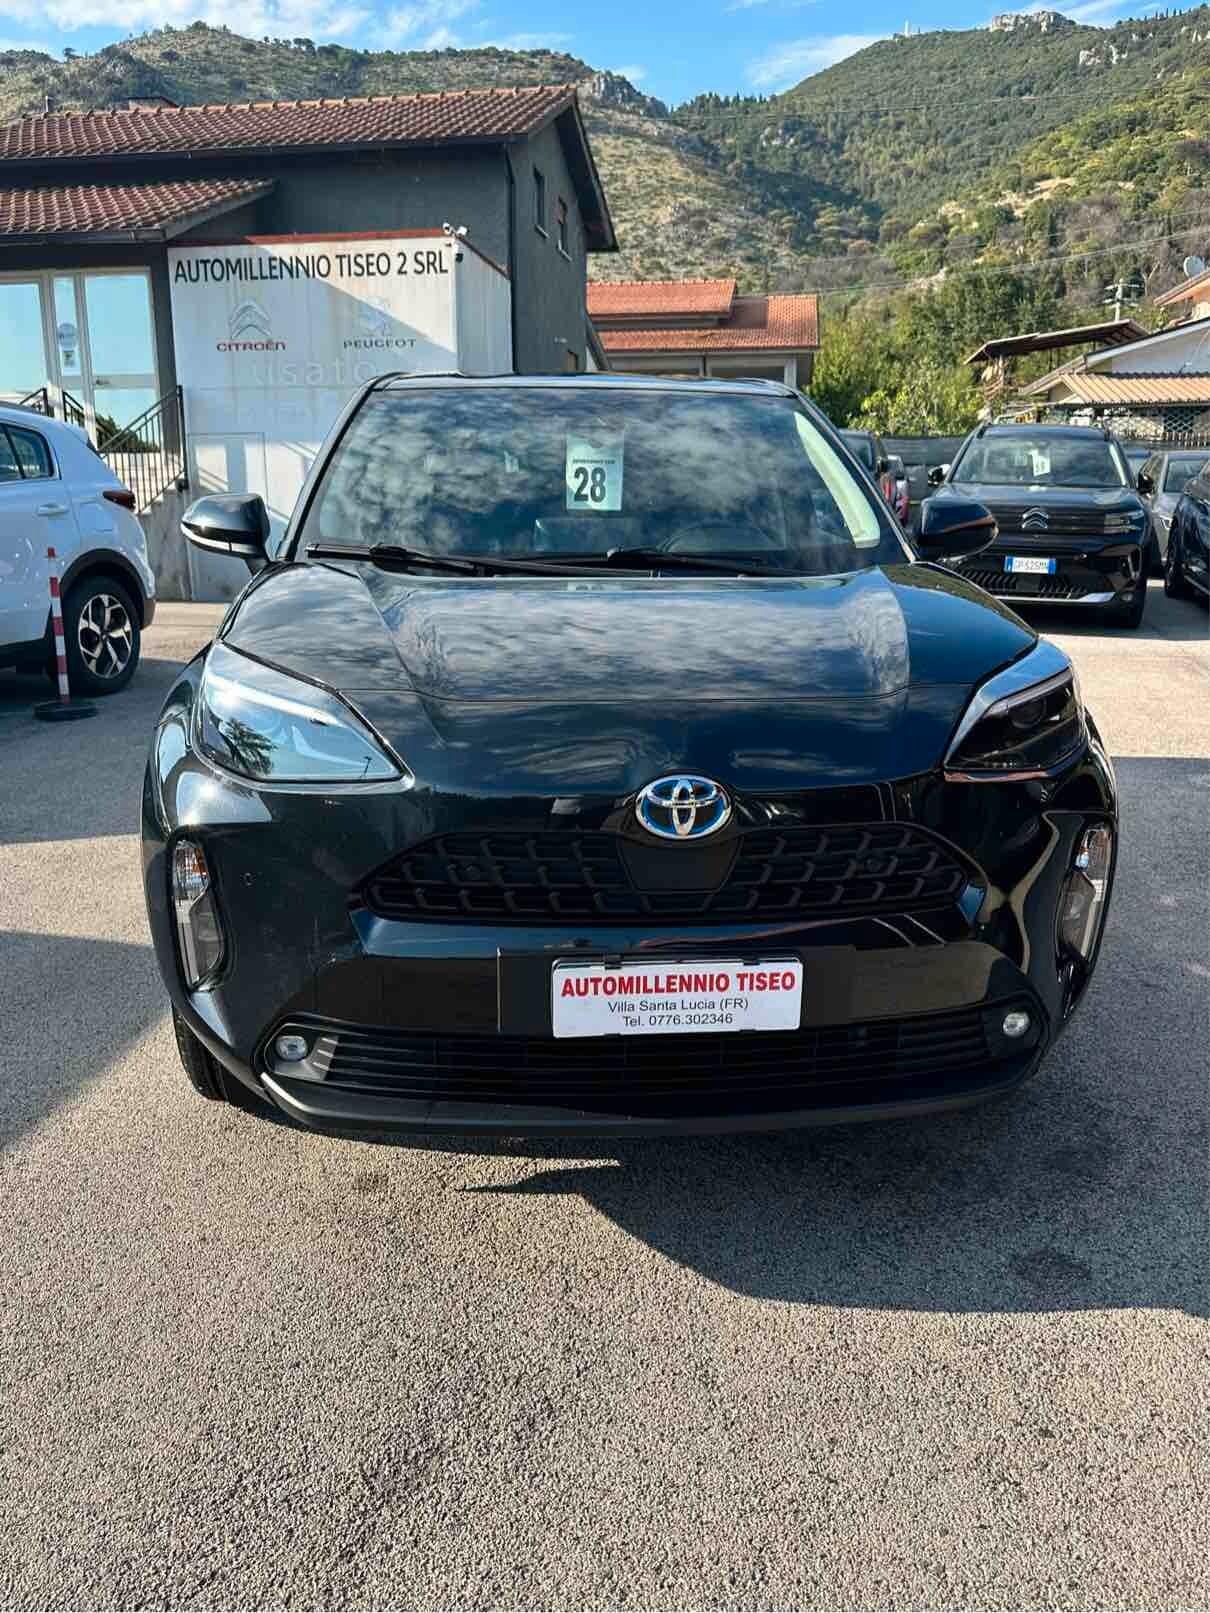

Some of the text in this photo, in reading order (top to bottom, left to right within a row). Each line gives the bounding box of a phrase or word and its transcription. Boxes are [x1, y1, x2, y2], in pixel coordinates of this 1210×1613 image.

[174, 251, 448, 283] AUTOMILLENNIO TISEO 2 SRL
[216, 339, 286, 352] CITROËN
[343, 338, 417, 349] PEUGEOT
[574, 467, 606, 503] 28
[561, 971, 796, 997] AUTOMILLENNIO TISEO
[607, 998, 749, 1014] Villa Santa Lucia (FR)
[623, 1012, 734, 1027] Tel. 0776.302346
